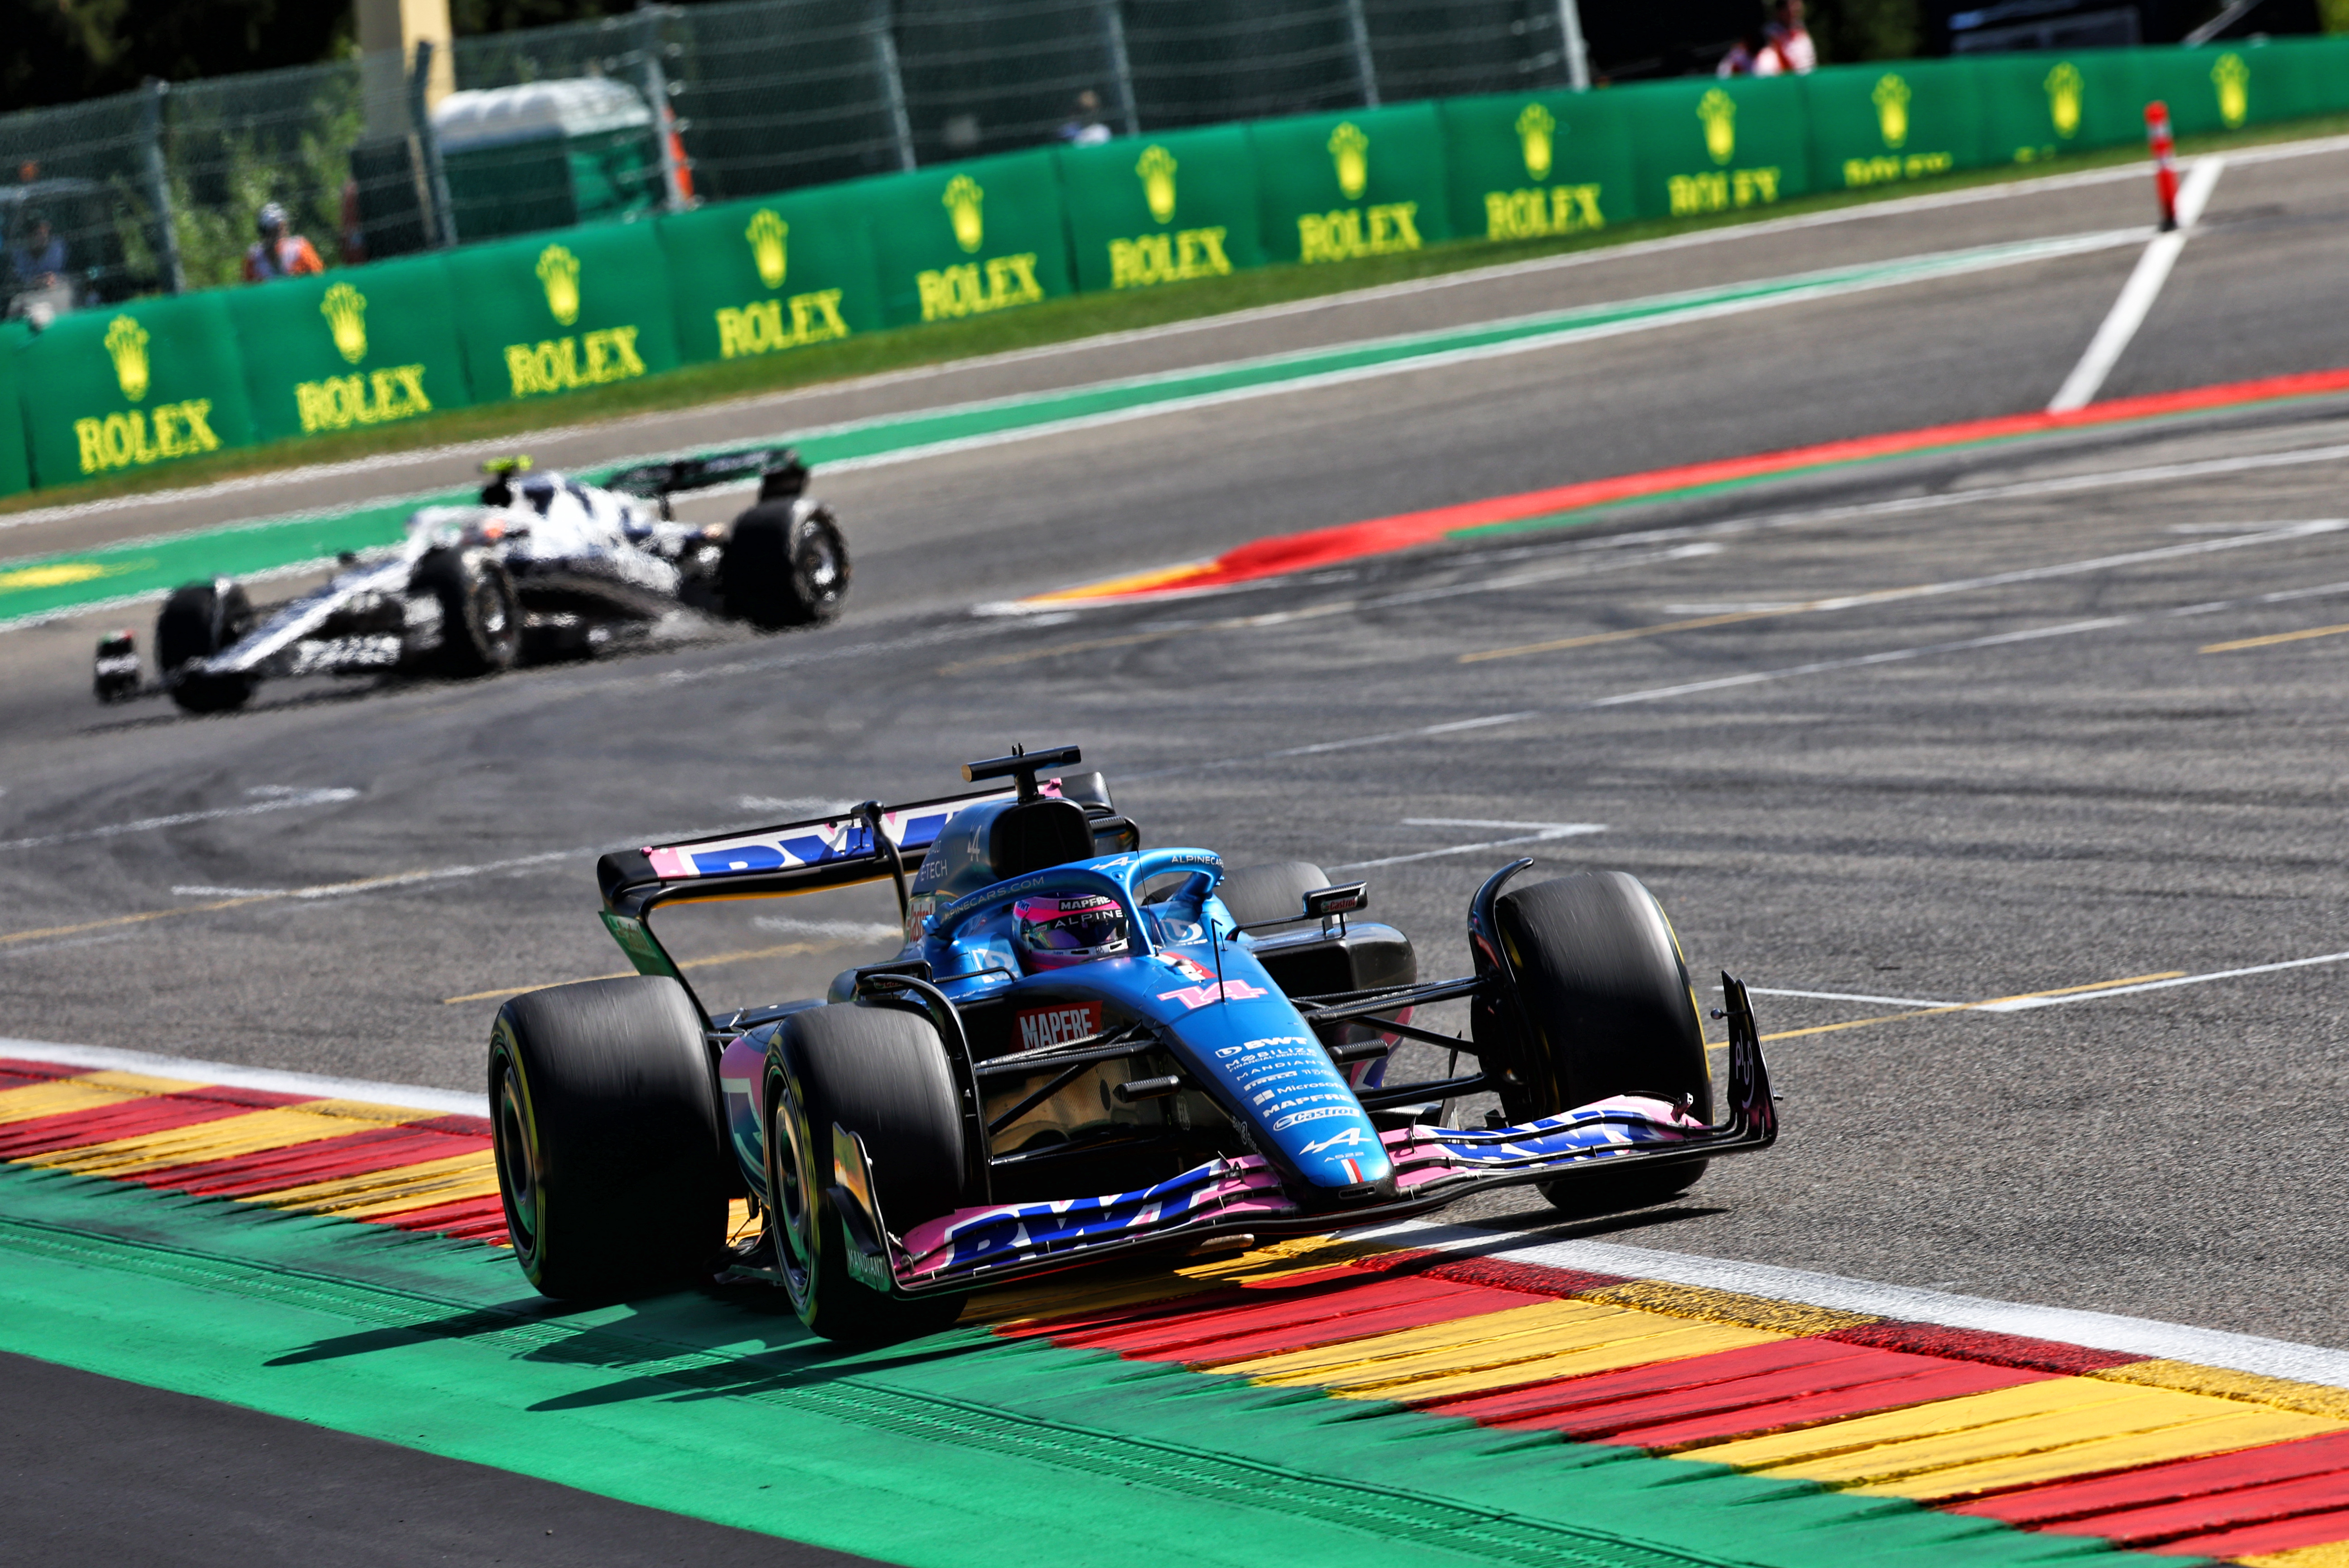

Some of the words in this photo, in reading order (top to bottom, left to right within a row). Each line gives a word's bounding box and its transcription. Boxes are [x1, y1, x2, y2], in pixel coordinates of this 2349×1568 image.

[1485, 183, 1605, 242] ROLEX
[1297, 200, 1423, 263] ROLEX
[1108, 226, 1232, 289] ROLEX
[916, 252, 1045, 322] ROLEX
[715, 288, 851, 358] ROLEX
[504, 325, 646, 398] ROLEX
[295, 363, 433, 434] ROLEX
[73, 398, 221, 474] ROLEX
[921, 859, 947, 882] E-TECH
[1061, 896, 1110, 910] MAPFRE
[1330, 898, 1356, 910] Castrol
[1054, 910, 1123, 929] ALPINE
[1156, 979, 1269, 1010] 14
[1020, 1008, 1092, 1049] MAPFRE
[1244, 1037, 1307, 1050] BWT
[1230, 1056, 1274, 1072] FINANCIAL
[1236, 1060, 1326, 1081] MANDIANT
[1244, 1071, 1297, 1091] PIRELLI
[1277, 1082, 1345, 1094] Microsoft
[1263, 1094, 1354, 1118] MAPFRE
[1294, 1108, 1355, 1121] Castrol
[1232, 1115, 1241, 1134] Bell
[1248, 1134, 1257, 1153] Ross
[1324, 1152, 1364, 1162] A522
[847, 1248, 883, 1278] MANDIANT
